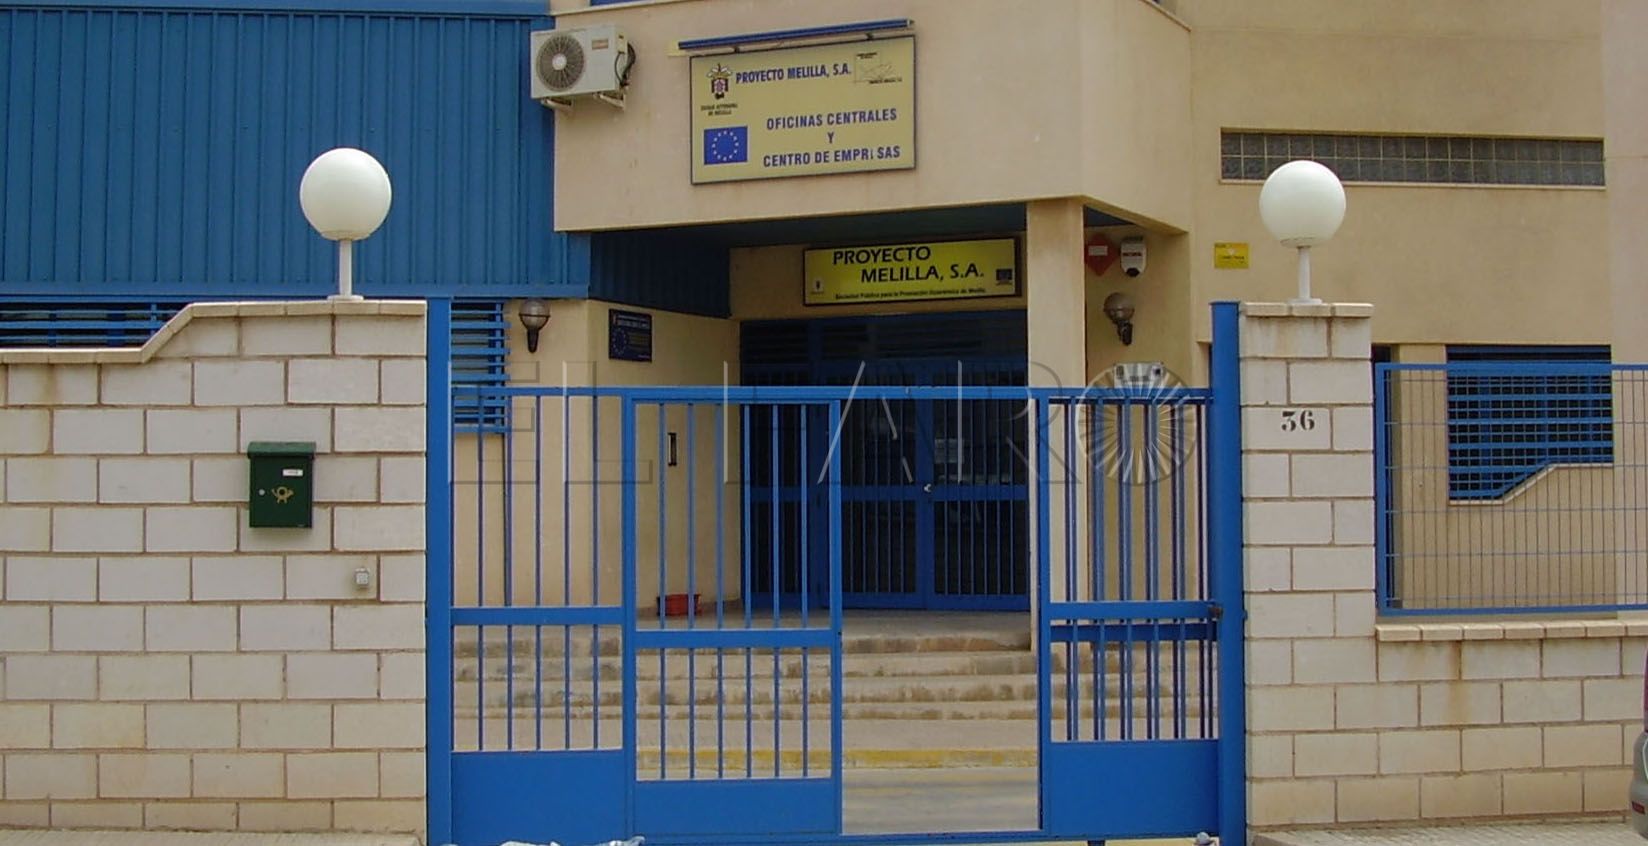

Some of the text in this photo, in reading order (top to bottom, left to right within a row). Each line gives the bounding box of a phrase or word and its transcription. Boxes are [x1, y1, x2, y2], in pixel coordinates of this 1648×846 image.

[736, 63, 852, 84] PROYECTO MELILLA, S.A.
[766, 108, 897, 130] OFICINAS CENTRALES
[827, 131, 835, 144] Y
[763, 152, 811, 168] CENTRO
[815, 150, 830, 164] DE
[833, 246, 931, 265] PROYECTO
[861, 263, 984, 283] MELILLA, S.A.
[1281, 409, 1315, 432] 36
